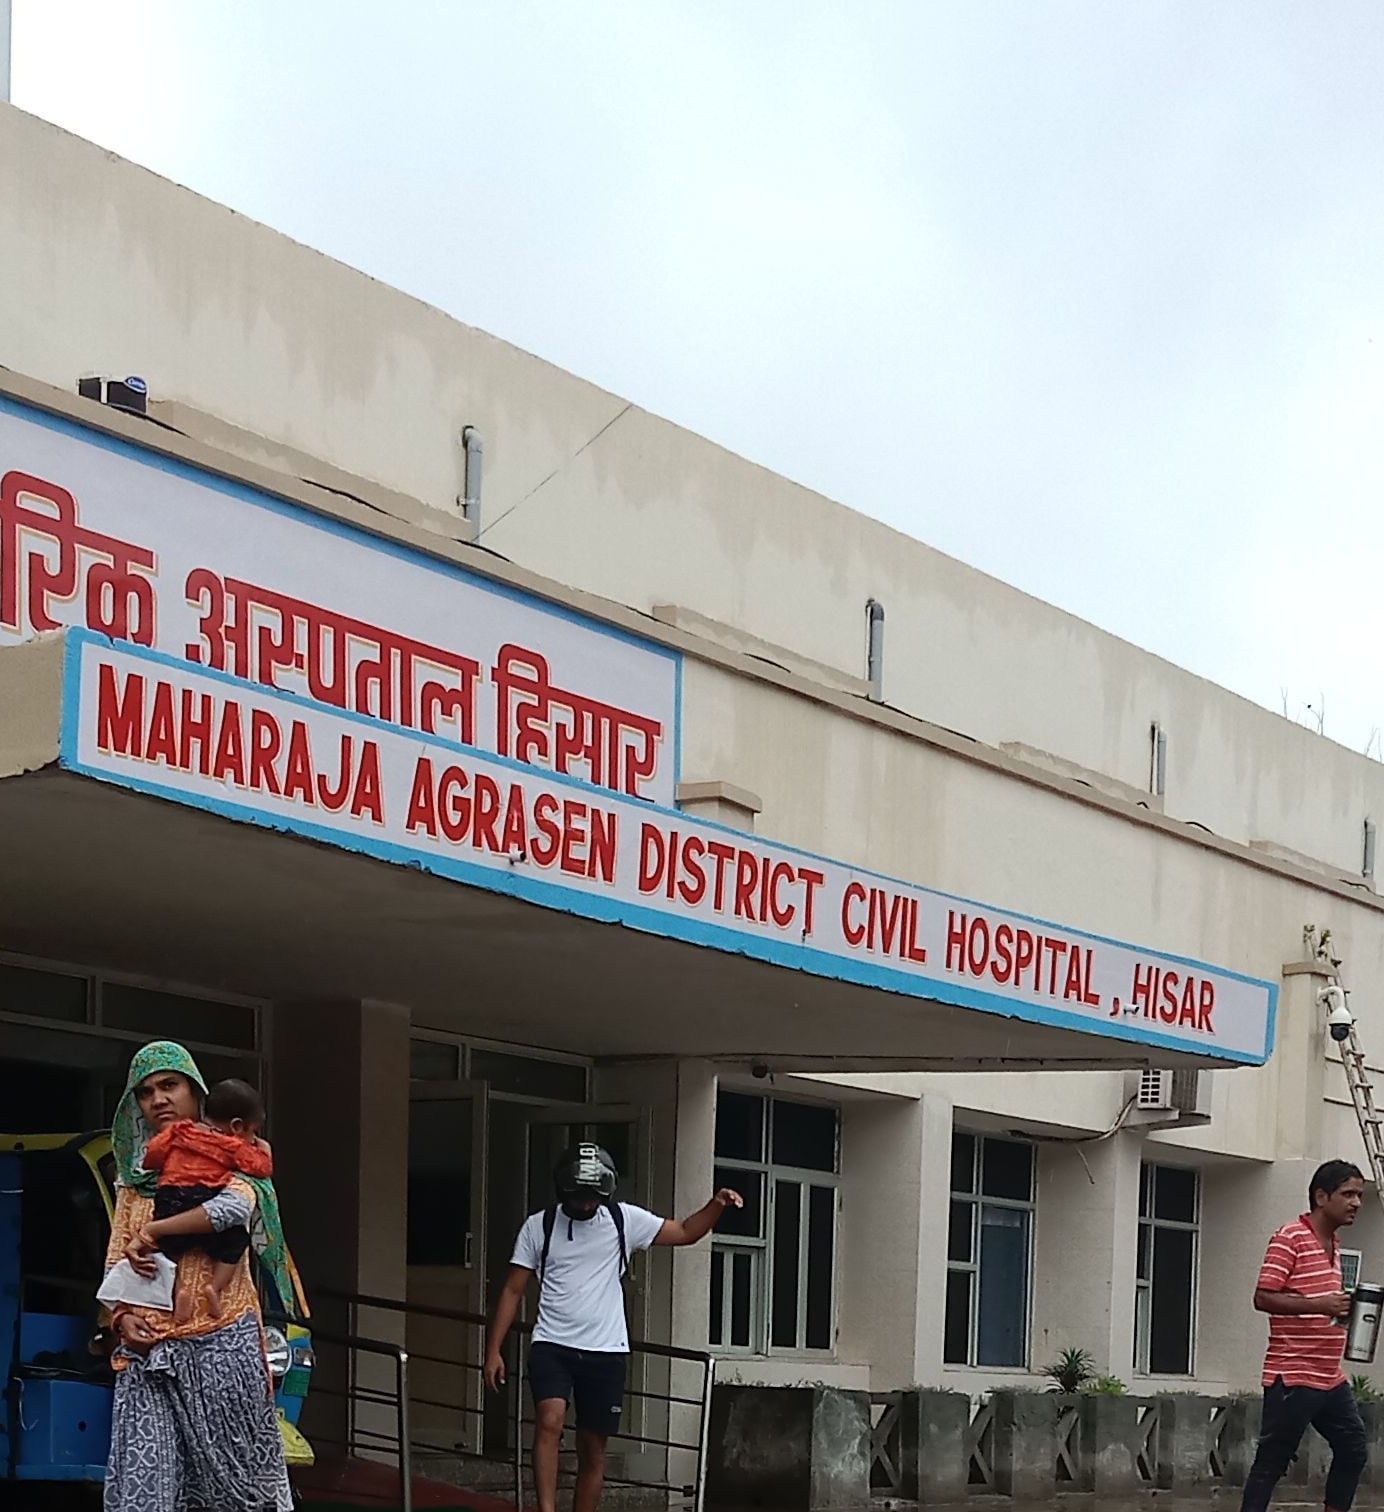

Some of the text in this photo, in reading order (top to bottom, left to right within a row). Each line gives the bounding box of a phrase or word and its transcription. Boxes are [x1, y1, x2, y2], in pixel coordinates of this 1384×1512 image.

[185, 568, 479, 744] अस्पताल
[492, 644, 662, 800] हिसार
[98, 664, 384, 824] MAHARAJA
[406, 757, 617, 882] AGRASEN
[638, 822, 824, 934] DISTRICT
[842, 882, 927, 963] CIVIL
[1132, 962, 1216, 1033] HISAR
